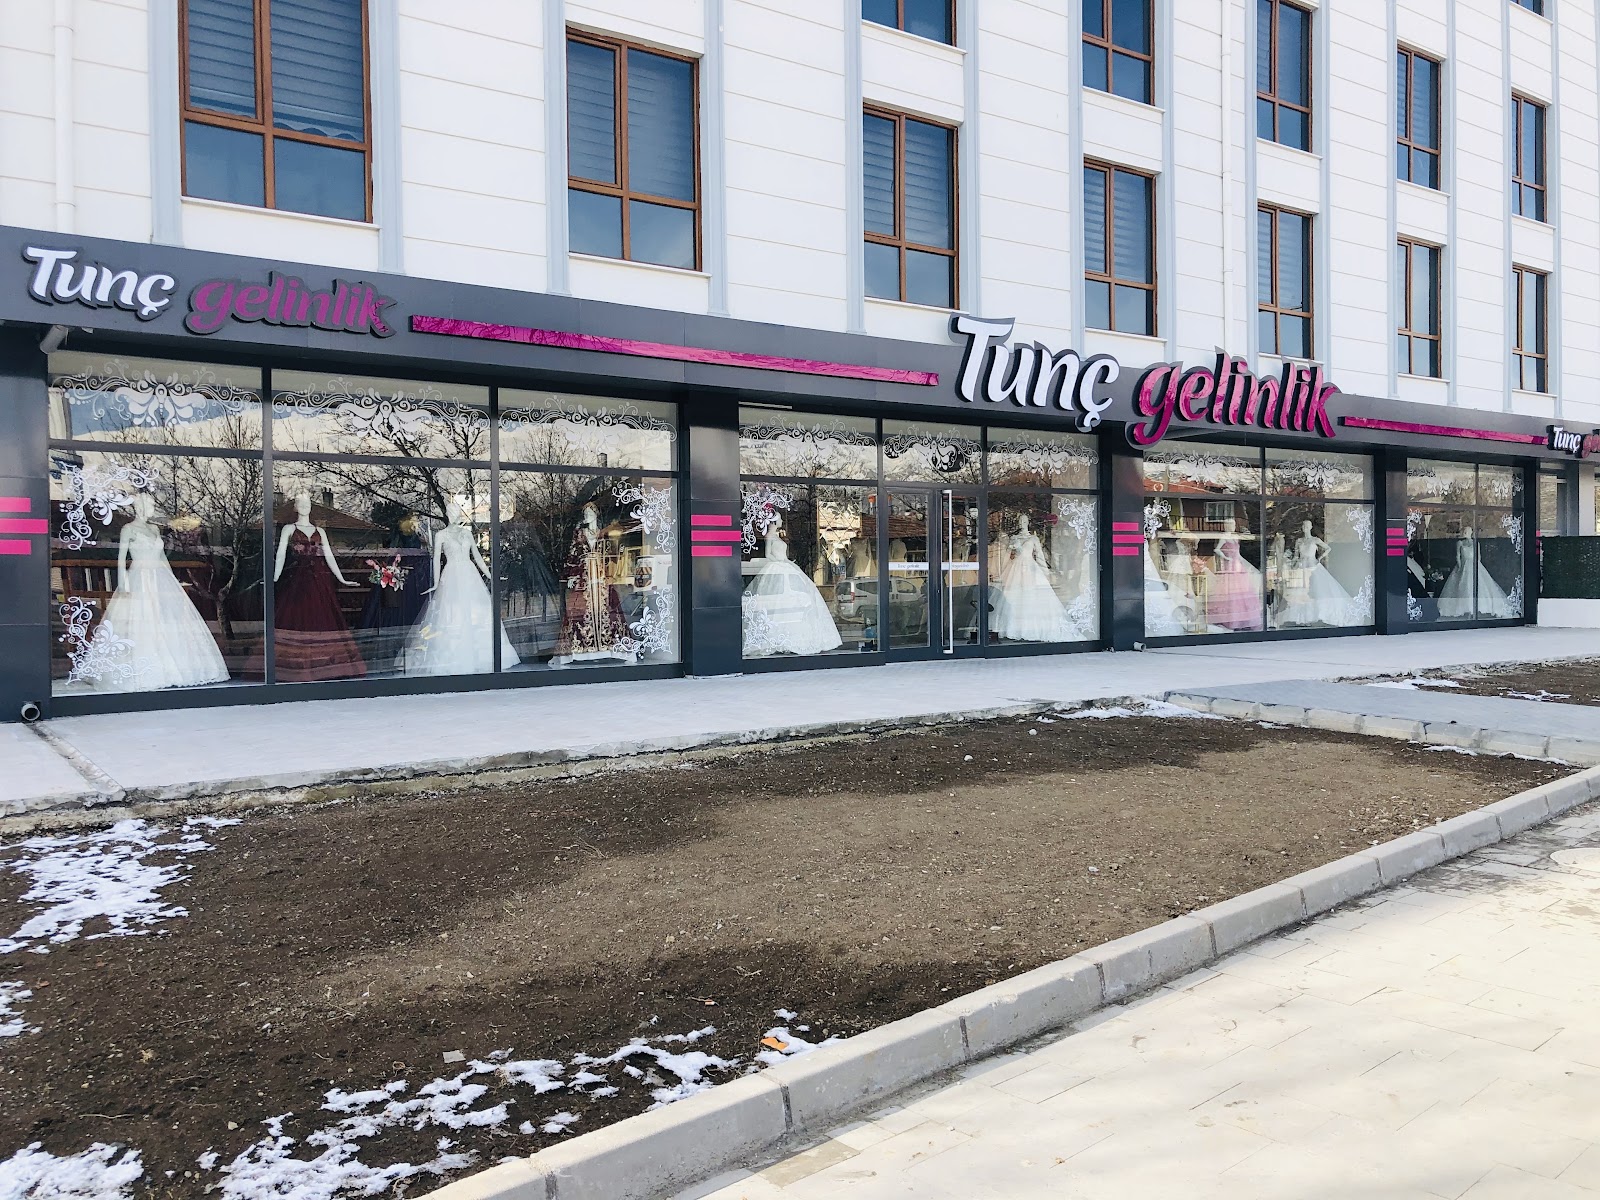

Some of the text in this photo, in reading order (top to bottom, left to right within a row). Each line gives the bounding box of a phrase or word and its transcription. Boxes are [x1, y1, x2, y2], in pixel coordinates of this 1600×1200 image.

[25, 246, 391, 333] Tunç gelinlik
[956, 316, 1338, 446] Tunç gelinlik
[1553, 427, 1582, 454] Tunç
